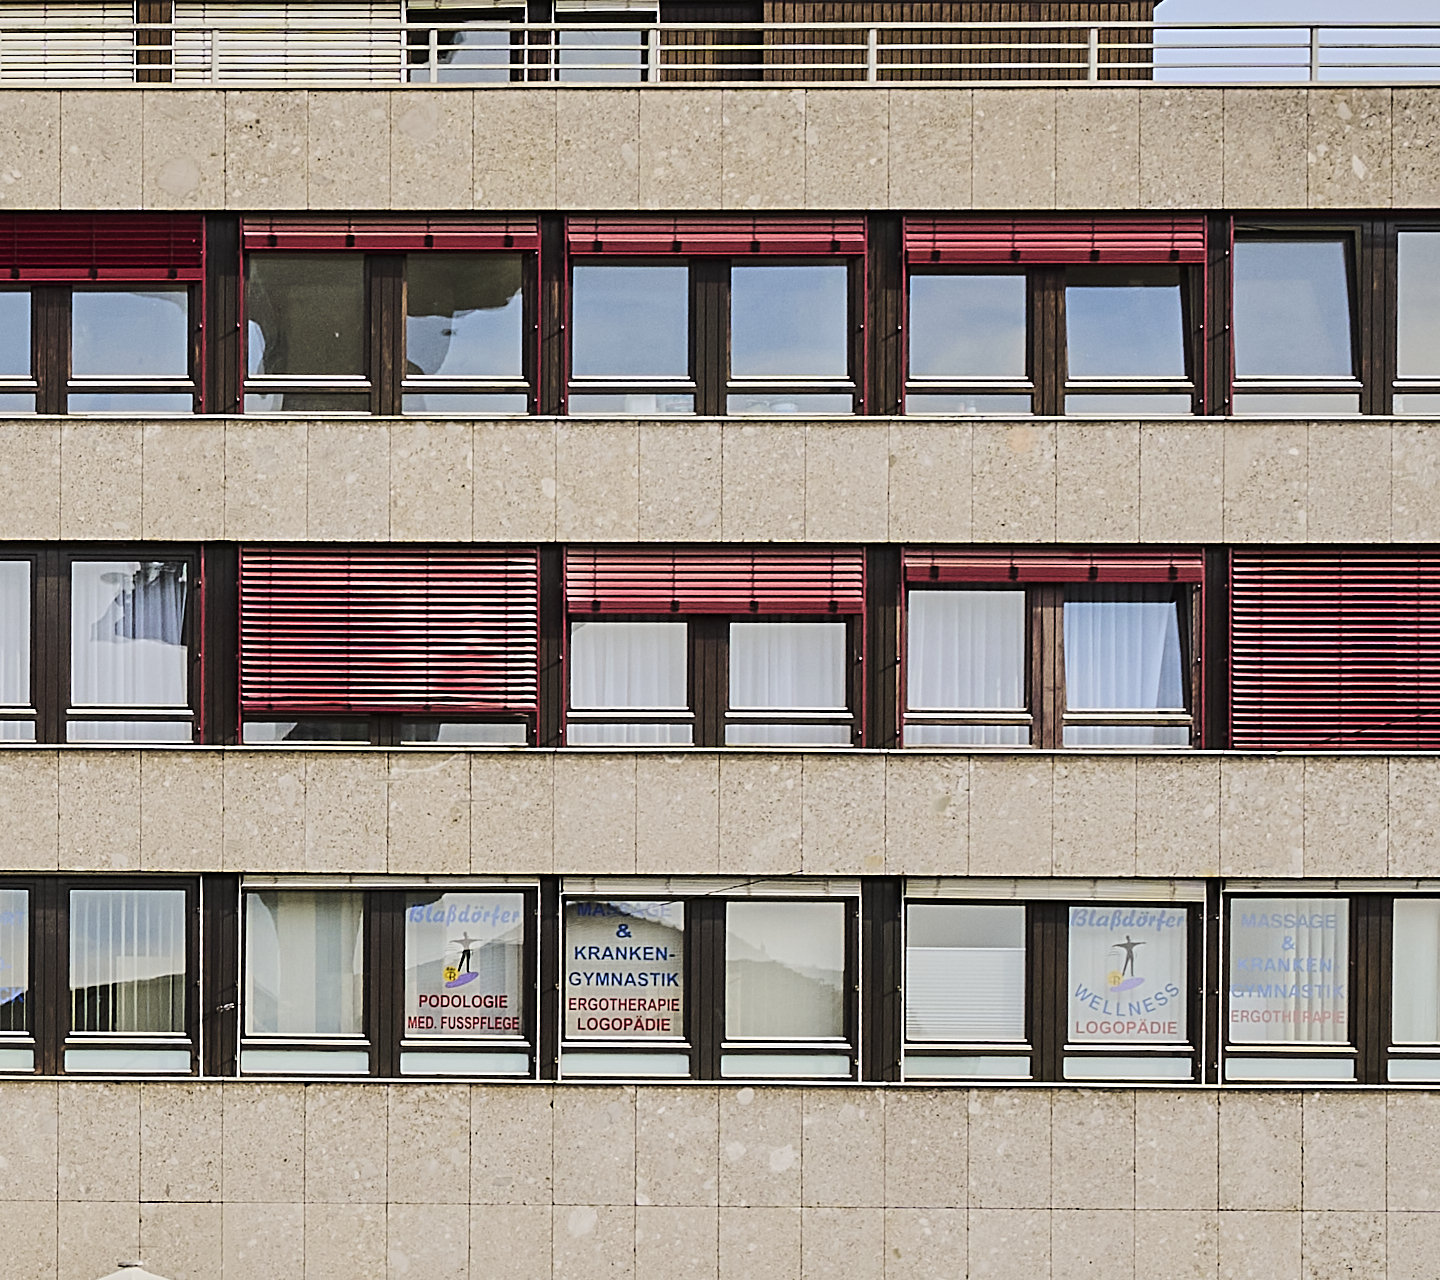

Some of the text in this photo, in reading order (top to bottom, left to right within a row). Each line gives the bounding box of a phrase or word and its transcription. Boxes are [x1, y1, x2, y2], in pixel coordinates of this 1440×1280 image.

[409, 903, 521, 926] Blaßdörfer
[576, 903, 672, 918] MASSAGE
[1071, 909, 1185, 931] Blaßdörfer
[1241, 914, 1337, 929] MASSAGE
[615, 924, 632, 939] &
[1281, 936, 1295, 950] &
[574, 946, 676, 961] KRANKEN-
[569, 972, 679, 987] GYMNASTIK
[1231, 984, 1345, 999] GYMNASTIK
[418, 995, 508, 1009] PODOLOGIE
[568, 997, 680, 1012] ERGOTHERAPIE
[1074, 983, 1180, 1017] WELLNESS
[408, 1016, 520, 1030] MED. FUSSPFLEGE
[577, 1015, 671, 1032] LOGOPÄDIE
[1231, 1010, 1345, 1024] ERGOTHERAPIE
[1075, 1019, 1178, 1035] LOGOPÄDIE
